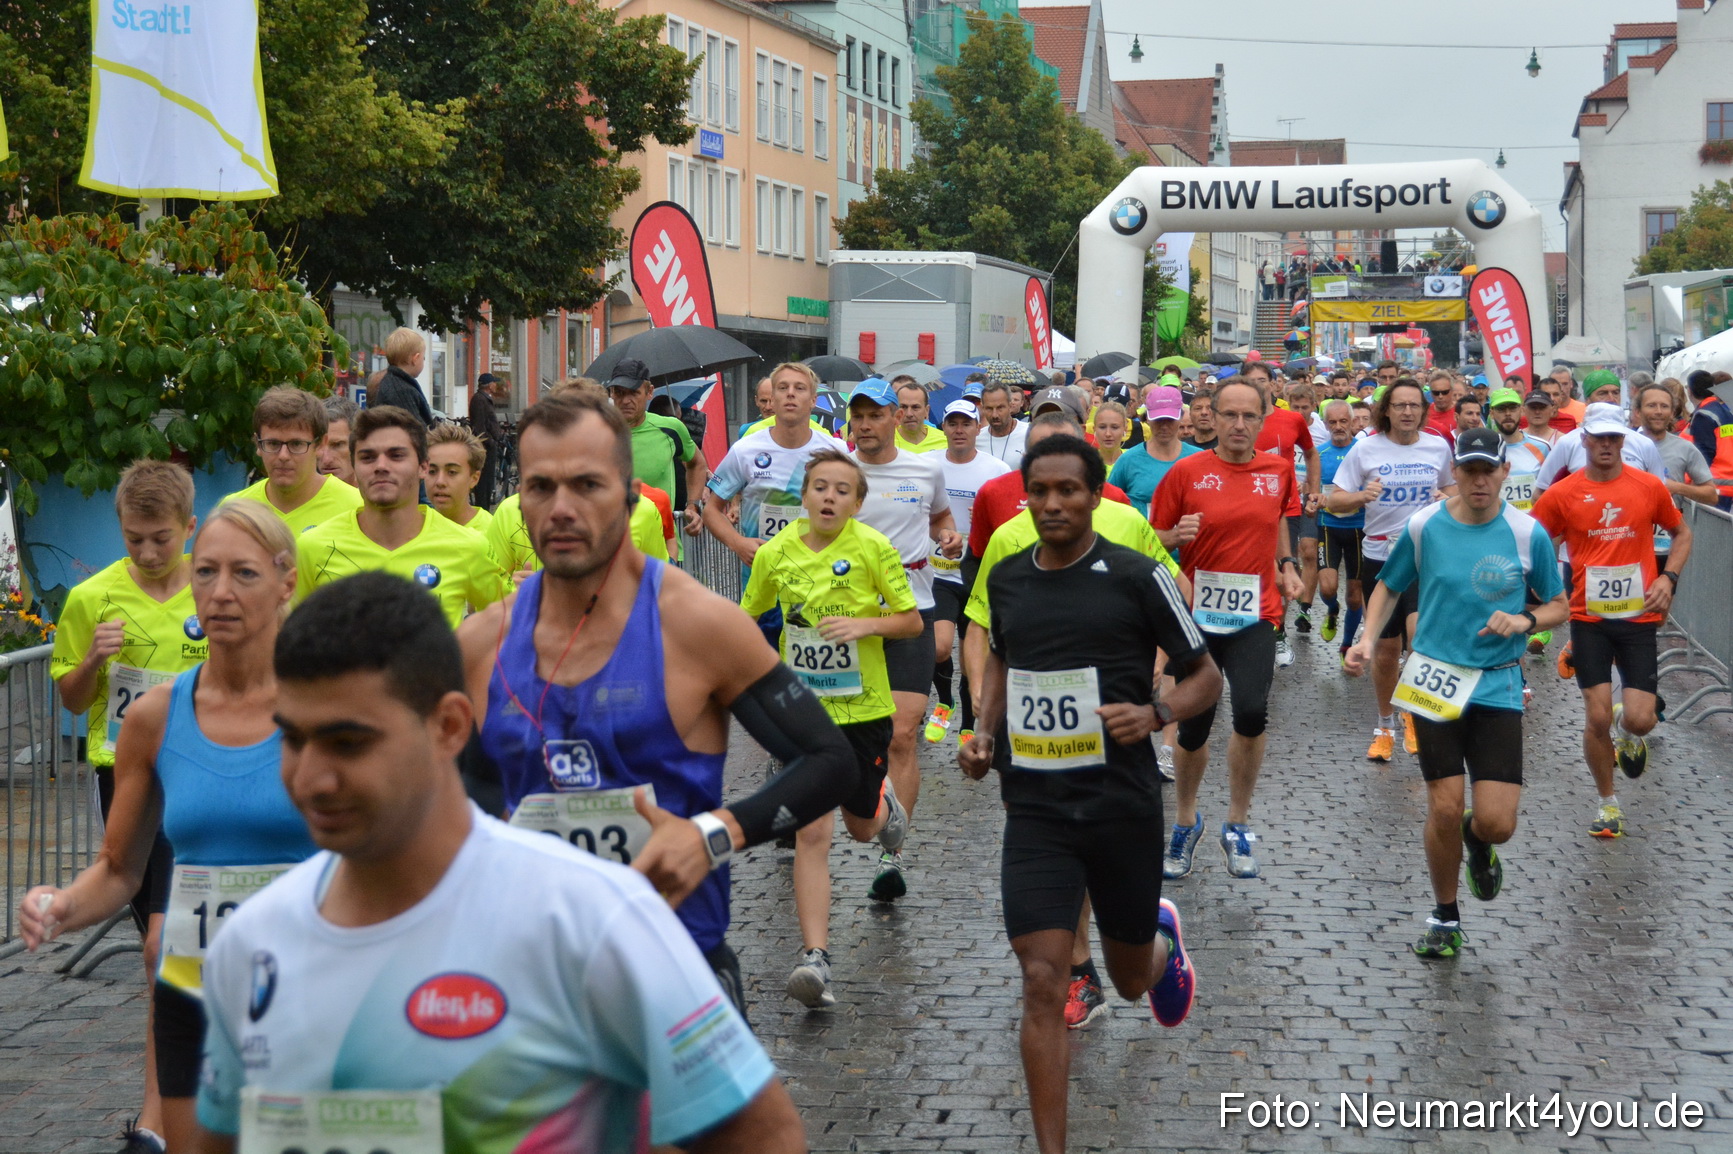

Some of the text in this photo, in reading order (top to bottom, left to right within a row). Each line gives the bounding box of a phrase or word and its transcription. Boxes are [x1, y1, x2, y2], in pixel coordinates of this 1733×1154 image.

[112, 0, 191, 34] Stadt!
[1160, 177, 1451, 213] BMW Laufsport
[1470, 191, 1504, 204] BMW
[1371, 305, 1406, 317] ZIEL
[1479, 281, 1526, 374] REWE
[1394, 468, 1434, 476] STIFTUNG
[1193, 482, 1212, 490] Spitz
[1380, 486, 1431, 502] 2015
[1505, 484, 1532, 501] 215
[1588, 526, 1630, 537] funrunners
[1600, 532, 1635, 542] neumarkt
[1598, 577, 1632, 599] 297
[1201, 586, 1254, 612] 2792
[1604, 602, 1628, 612] Harald
[809, 604, 845, 614] THE NEXT
[1206, 614, 1244, 627] Bernhard
[792, 643, 851, 670] 2823
[807, 675, 838, 688] Moritz
[1036, 673, 1087, 687] BOCK
[1413, 663, 1461, 699] 355
[1409, 690, 1443, 713] Thomas
[1021, 694, 1079, 732] 236
[1014, 738, 1097, 758] Girma Ayalew
[551, 746, 592, 776] a3
[540, 825, 632, 867] 03
[220, 871, 281, 888] BOC
[417, 988, 495, 1023] Hervis
[319, 1099, 418, 1124] BOCK
